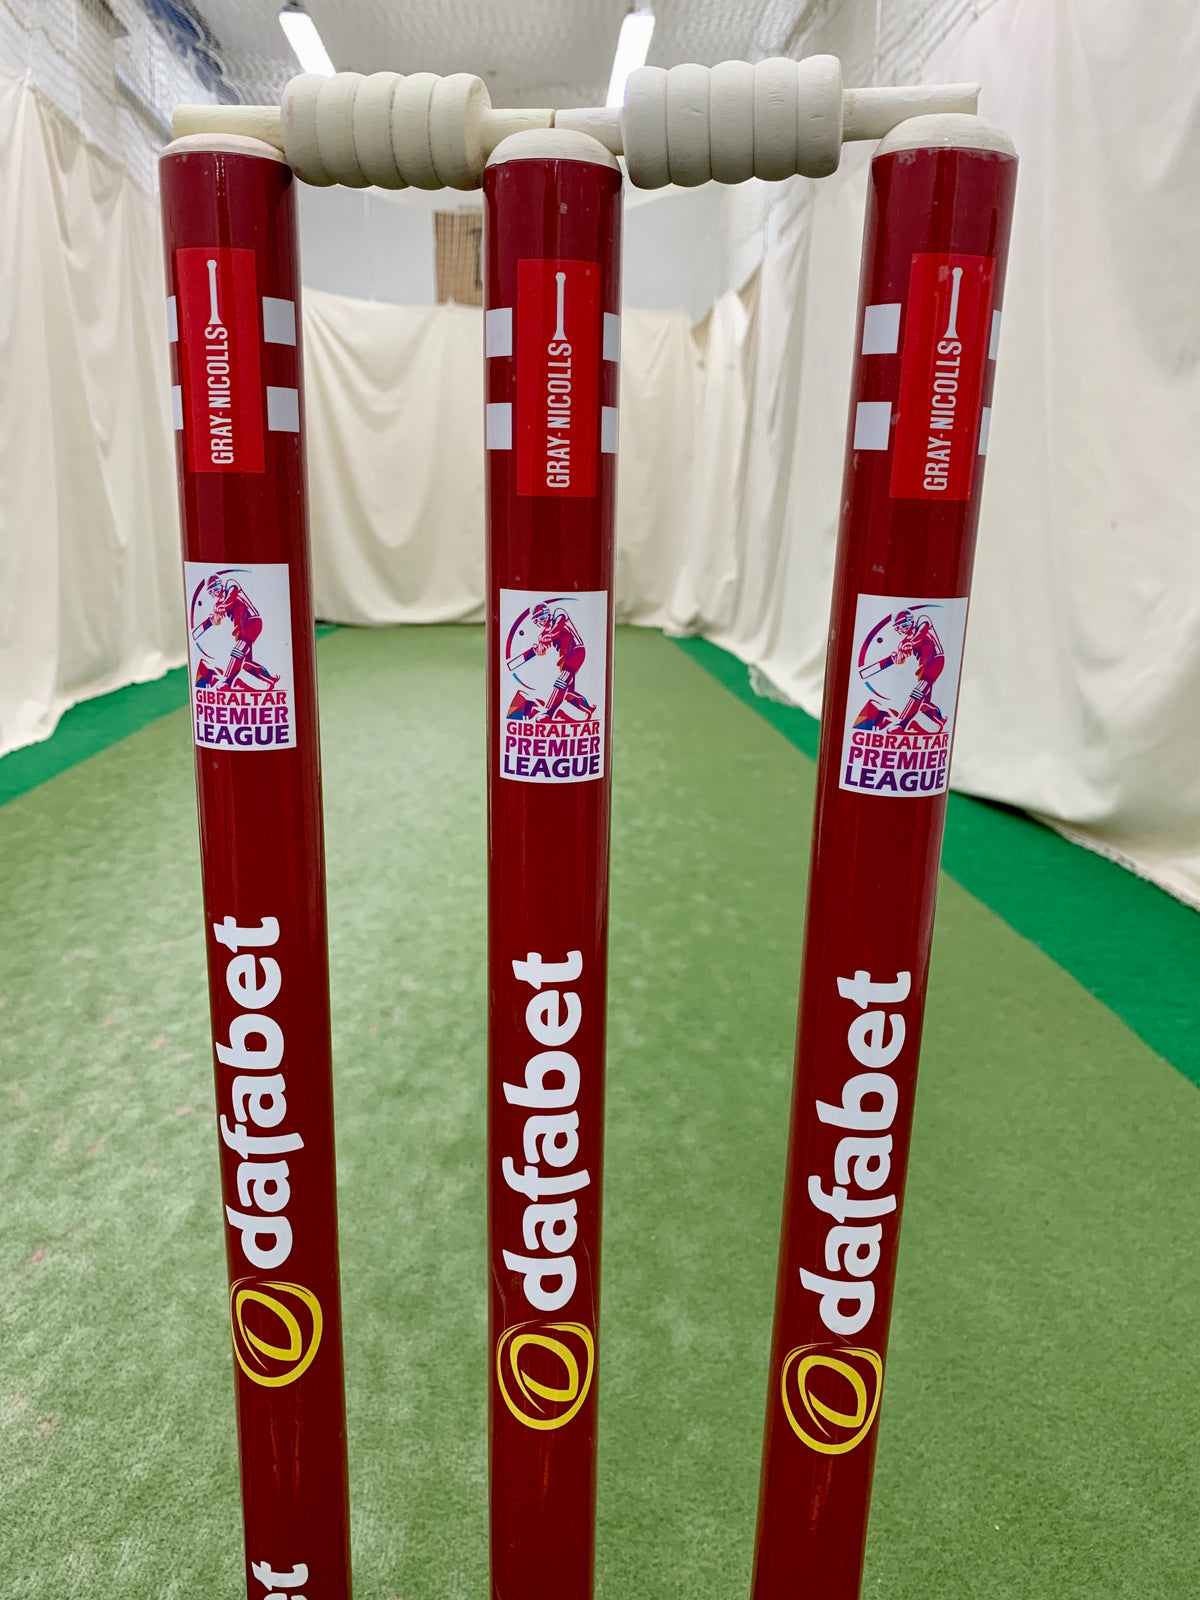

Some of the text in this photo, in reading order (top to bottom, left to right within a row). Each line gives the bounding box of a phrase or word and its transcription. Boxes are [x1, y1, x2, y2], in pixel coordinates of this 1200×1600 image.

[204, 327, 234, 464] GRAY-NICOLLS
[546, 343, 572, 488] GRAY-NICOLLS
[923, 340, 962, 491] GRAY-NICOLLS
[196, 690, 287, 706] GIBRALTAR
[196, 704, 288, 725] PREMIER
[196, 722, 289, 746] LEAGUE
[506, 721, 600, 738] GIBRALTAR
[852, 731, 949, 750] GIBRALTAR
[505, 736, 600, 757] PREMIER
[849, 746, 948, 770] PREMIER
[504, 754, 600, 778] LEAGUE
[844, 765, 946, 792] LEAGUE
[213, 915, 304, 1269] dafabet
[501, 950, 591, 1311] dafabet
[799, 970, 911, 1335] dafabet
